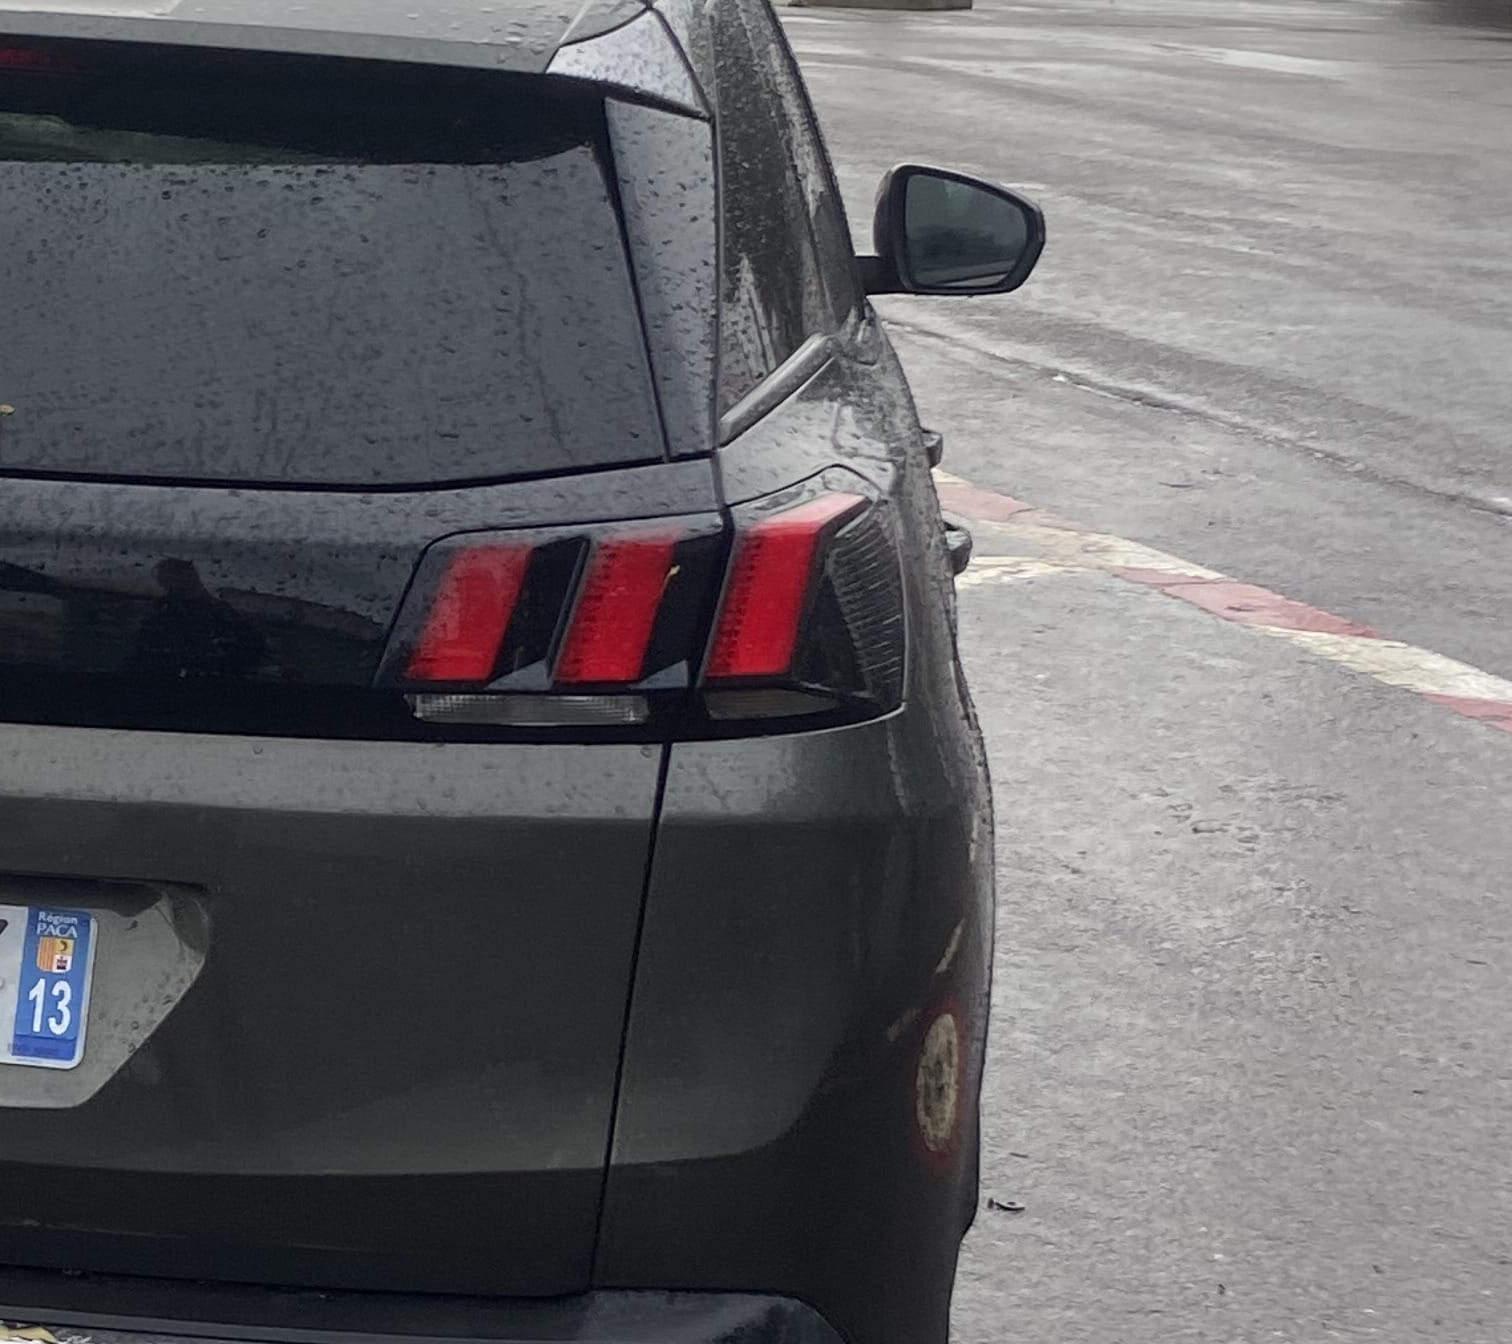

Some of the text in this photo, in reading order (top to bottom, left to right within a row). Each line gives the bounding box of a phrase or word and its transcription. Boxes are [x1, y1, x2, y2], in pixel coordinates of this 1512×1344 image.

[38, 911, 78, 925] Région
[36, 922, 78, 938] PACA
[29, 977, 72, 1035] 13
